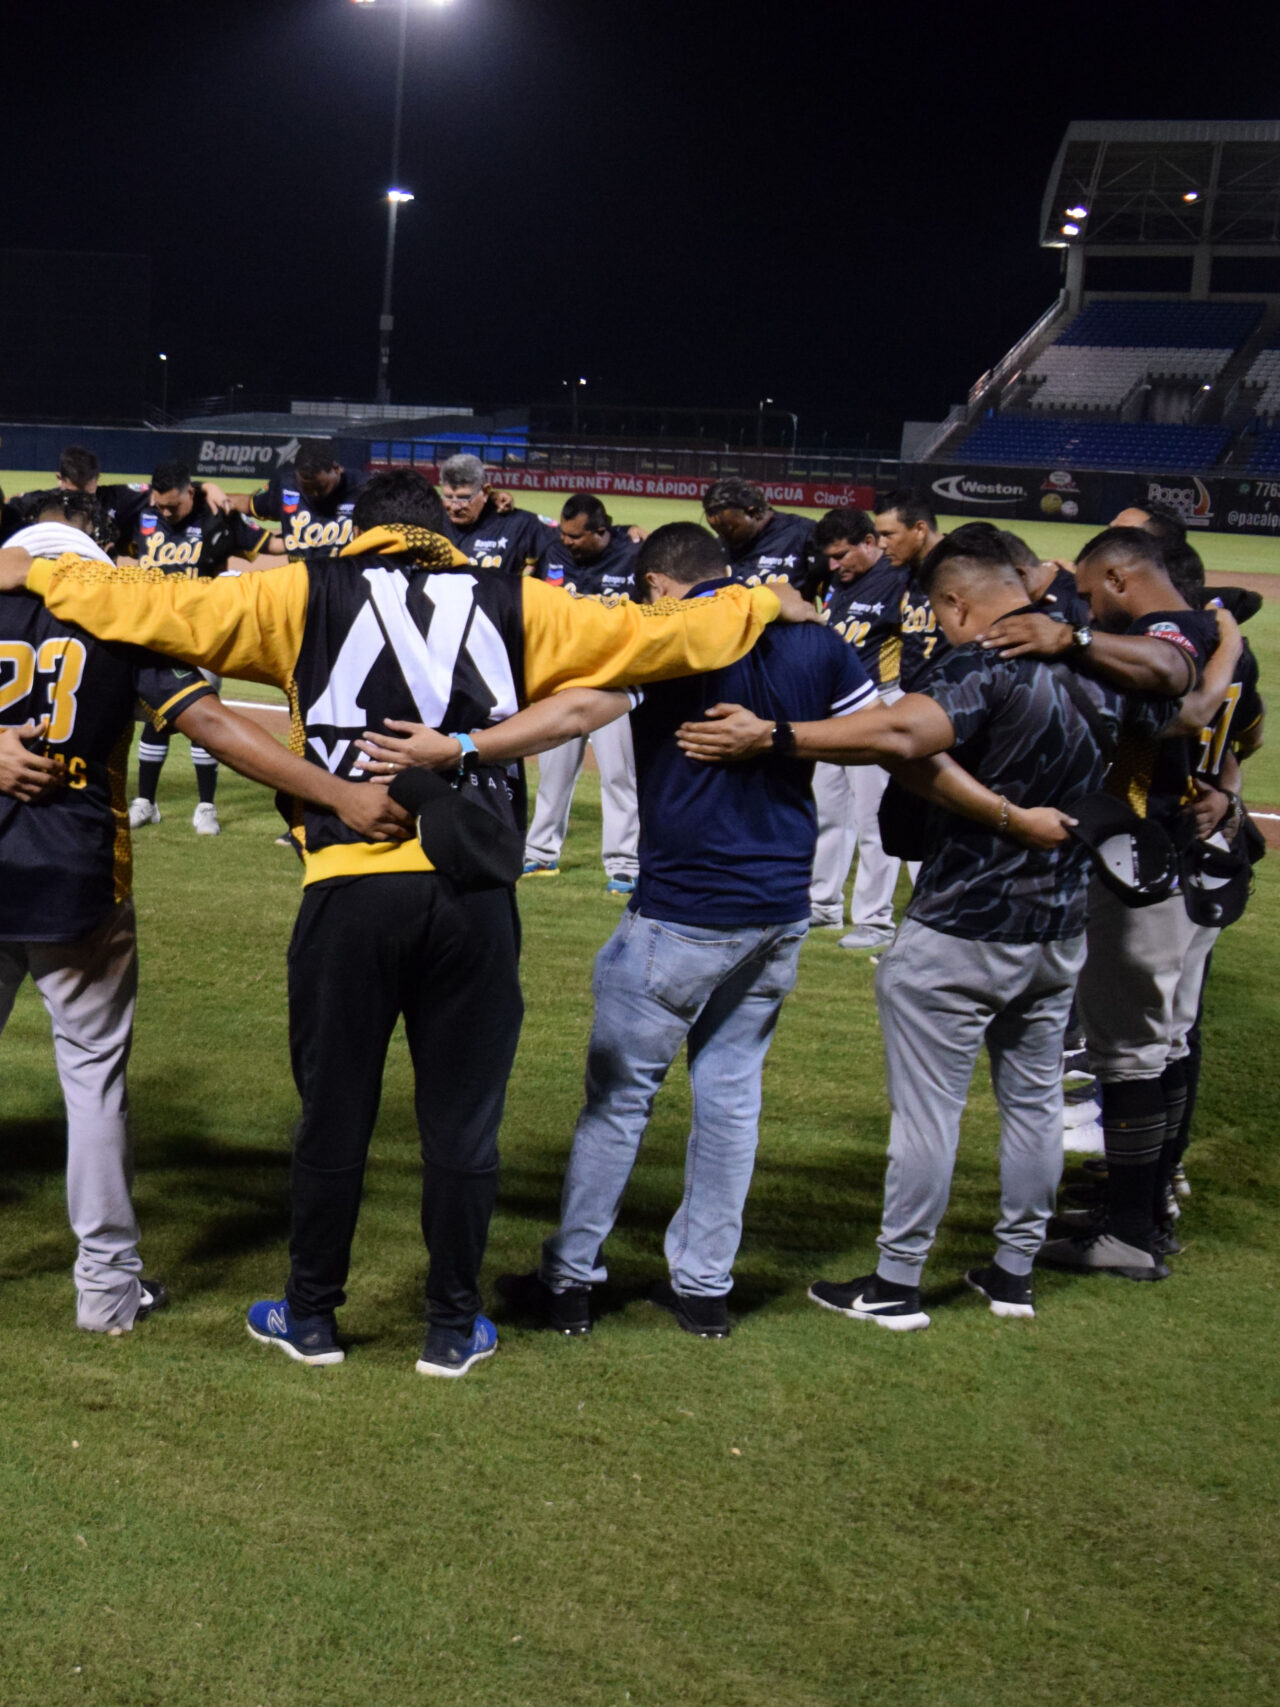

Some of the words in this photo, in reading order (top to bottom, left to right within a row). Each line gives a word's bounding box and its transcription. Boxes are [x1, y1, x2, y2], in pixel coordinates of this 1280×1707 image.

[200, 440, 273, 464] Banpro
[523, 474, 541, 488] AL
[544, 475, 611, 490] INTERNET
[614, 473, 644, 493] MÁS
[646, 476, 698, 496] RÁPIDO
[814, 491, 849, 507] Claro
[923, 636, 938, 660] 7
